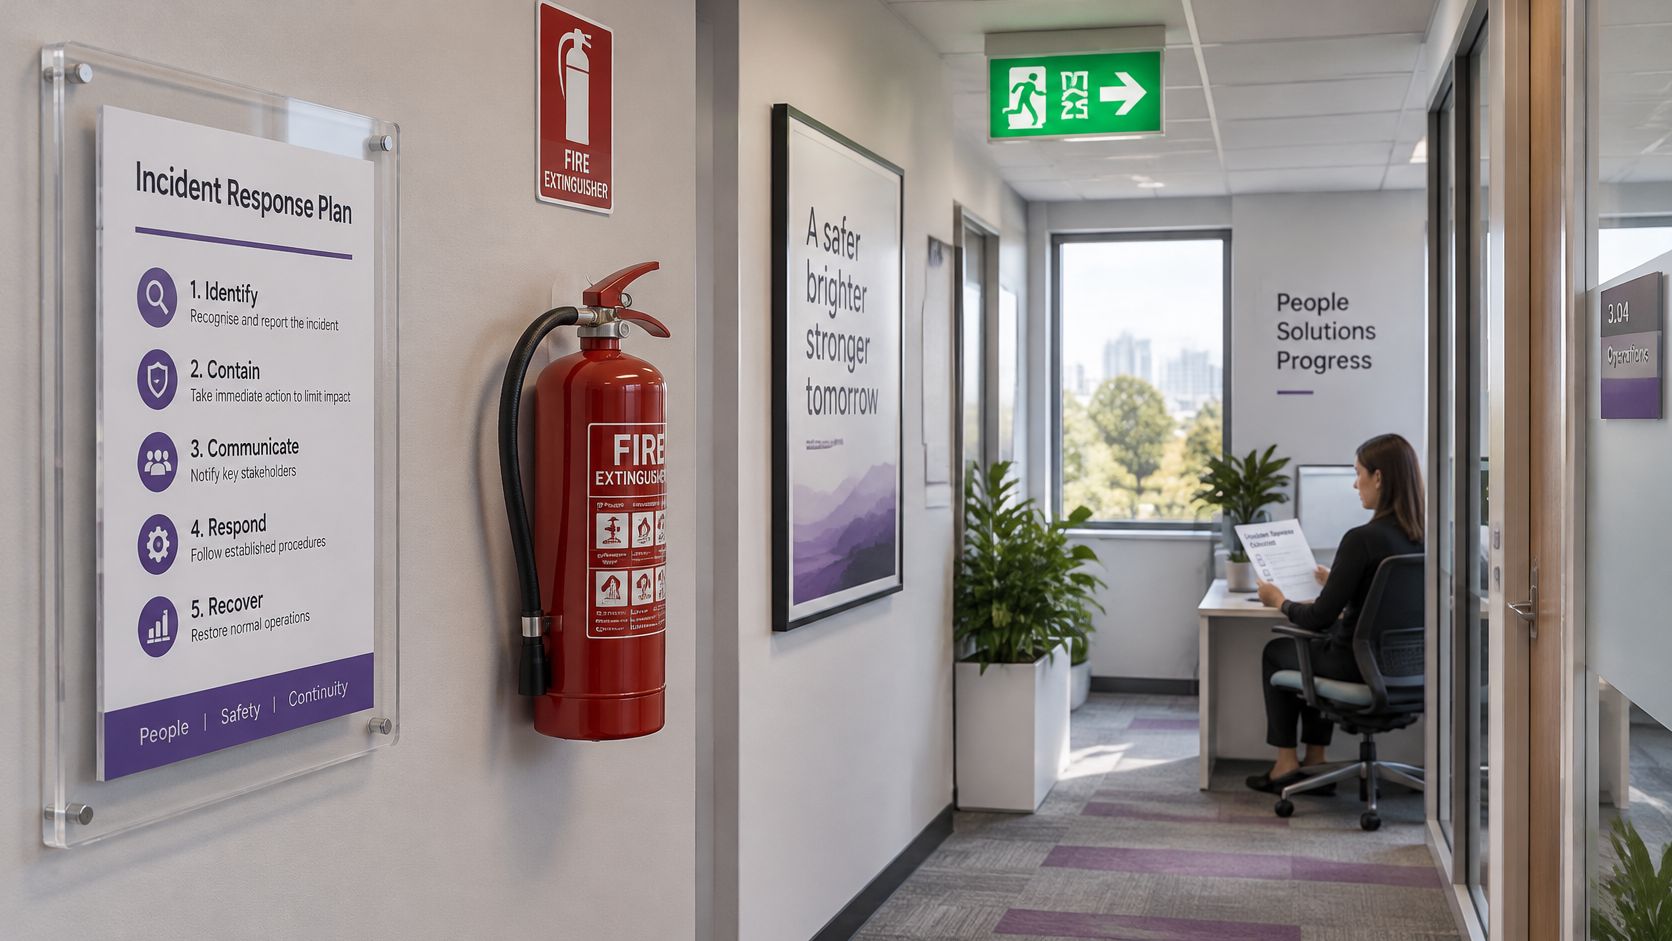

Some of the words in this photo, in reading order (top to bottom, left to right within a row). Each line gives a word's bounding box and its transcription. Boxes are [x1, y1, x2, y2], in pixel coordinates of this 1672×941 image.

[565, 148, 590, 174] FIRE
[136, 160, 222, 205] Incident
[227, 178, 314, 218] Response
[318, 194, 352, 225] Plan
[544, 170, 608, 200] EXTINGUISHER
[806, 206, 818, 248] A
[824, 215, 861, 262] safer
[190, 280, 202, 300] 1.
[205, 280, 258, 309] Identify
[806, 258, 868, 320] brighter
[1277, 292, 1349, 316] People
[1608, 300, 1630, 324] 3.04
[190, 308, 239, 327] Recognise
[241, 313, 259, 327] and
[261, 316, 288, 330] report
[290, 317, 304, 330] the
[306, 318, 339, 332] incident
[1276, 320, 1376, 341] Solutions
[806, 322, 870, 374] stronger
[190, 359, 203, 379] 2.
[207, 360, 260, 380] Contain
[1277, 350, 1372, 375] Progress
[190, 388, 213, 402] Take
[215, 388, 263, 403] immediate
[265, 390, 292, 403] action
[293, 391, 302, 403] to
[304, 390, 322, 403] limit
[324, 390, 351, 405] impact
[806, 377, 879, 416] tomorrow
[190, 439, 204, 458] 3.
[207, 437, 300, 458] Communicate
[614, 434, 665, 466] FIRE
[190, 468, 220, 483] Notify
[222, 467, 239, 484] key
[241, 464, 297, 480] stakeholders
[190, 519, 204, 538] 4.
[208, 513, 267, 540] Respond
[191, 546, 222, 562] Follow
[224, 540, 276, 558] established
[278, 536, 326, 556] procedures
[191, 599, 204, 618] 5.
[208, 593, 264, 617] Recover
[191, 624, 228, 642] Restore
[230, 618, 262, 636] normal
[264, 610, 310, 630] operations
[140, 720, 190, 746] People
[220, 702, 261, 725] Safety
[288, 680, 348, 707] Continuity
